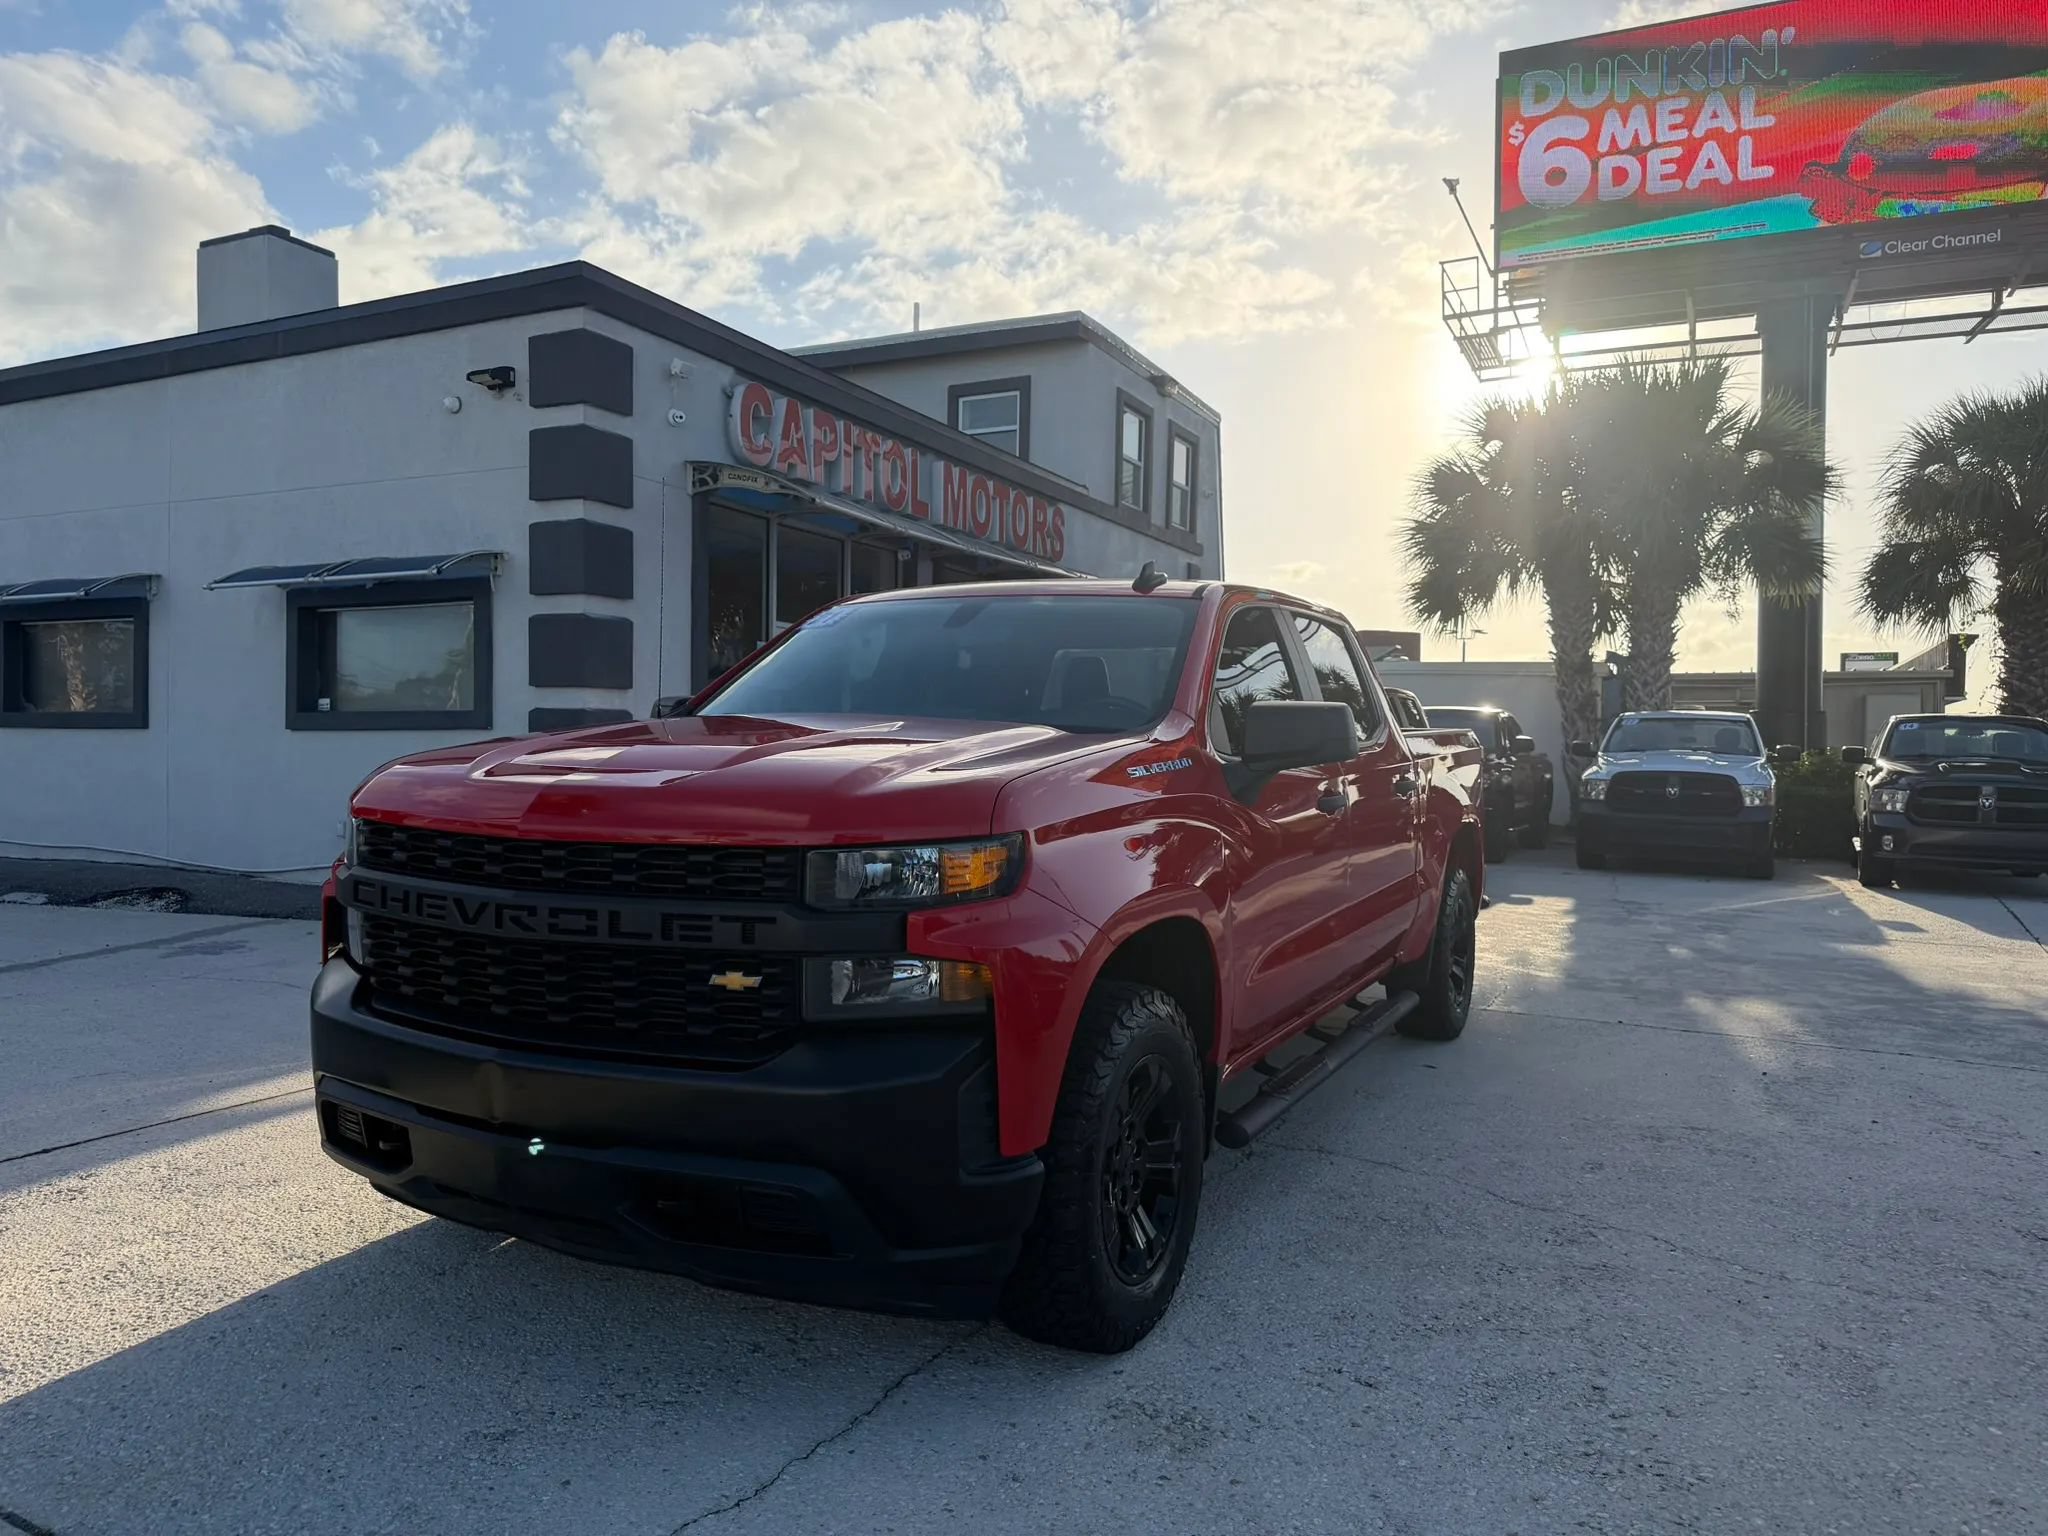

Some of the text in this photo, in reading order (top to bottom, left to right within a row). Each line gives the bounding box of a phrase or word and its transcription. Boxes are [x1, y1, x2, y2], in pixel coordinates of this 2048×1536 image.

[1598, 86, 1776, 152] MEAL
[1598, 136, 1774, 201] DEAL
[1884, 229, 2001, 255] Clear Channel
[732, 382, 1066, 562] CAPITOL MOTORS
[352, 879, 778, 945] CHEVROLET
